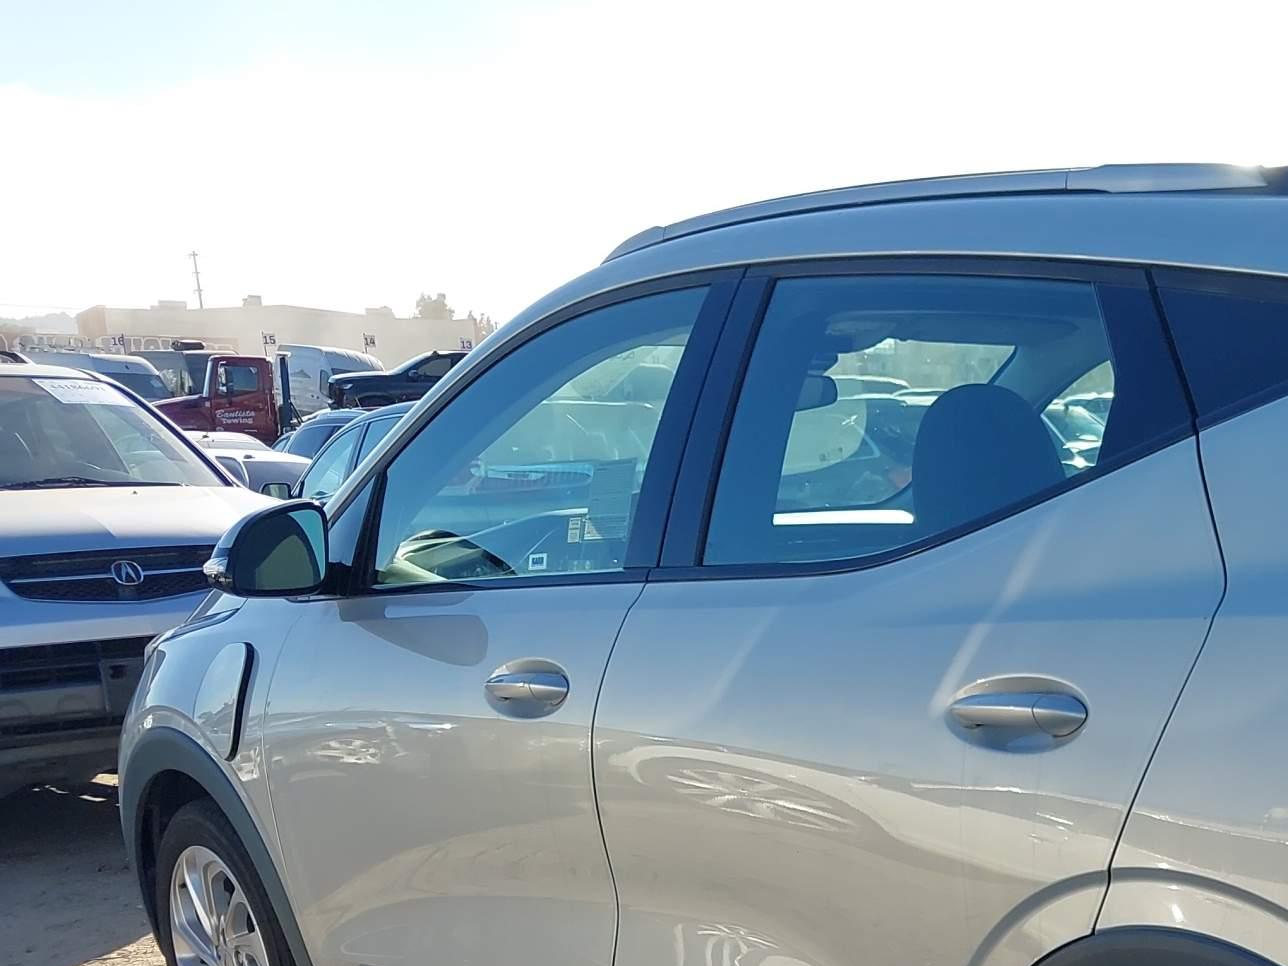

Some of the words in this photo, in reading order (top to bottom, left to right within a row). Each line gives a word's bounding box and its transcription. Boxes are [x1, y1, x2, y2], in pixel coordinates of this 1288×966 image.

[111, 336, 124, 346] 16
[262, 335, 276, 345] 15
[364, 335, 375, 346] 14
[460, 340, 472, 349] 13
